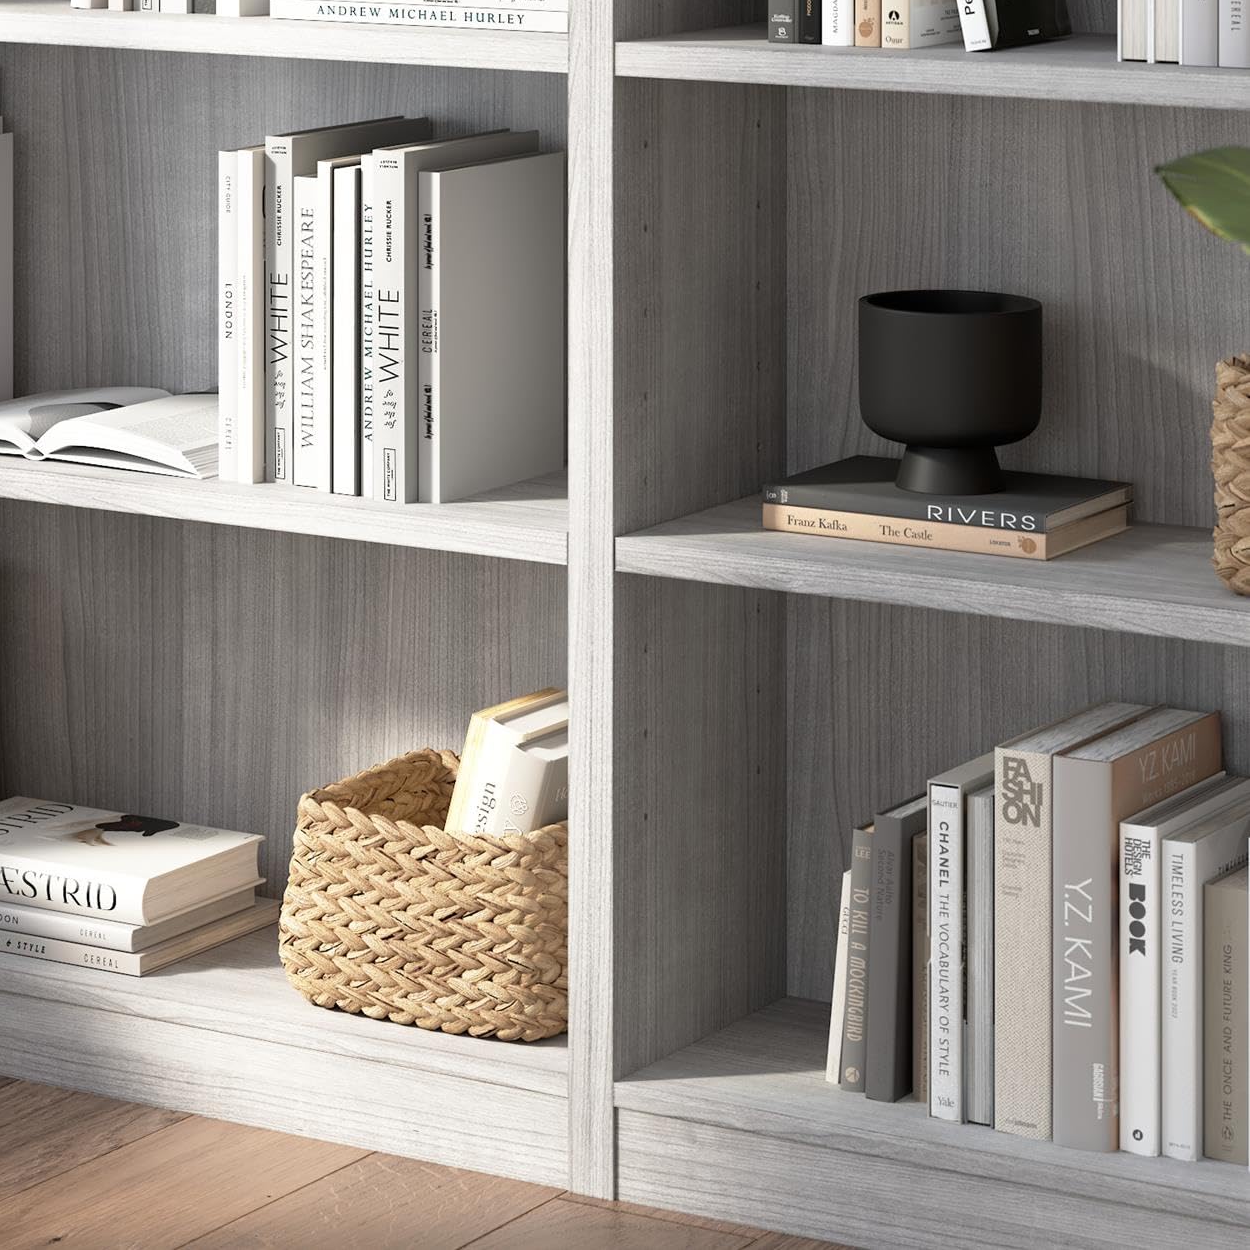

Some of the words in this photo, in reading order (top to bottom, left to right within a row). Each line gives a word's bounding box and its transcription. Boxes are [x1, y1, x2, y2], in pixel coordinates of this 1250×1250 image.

[316, 5, 382, 18] ANDREW
[388, 7, 457, 22] MICHAEL
[464, 11, 526, 25] HURLEY
[364, 203, 374, 272] HURLEY
[301, 207, 314, 350] SHAKESPEARE
[225, 282, 233, 339] LONDON
[270, 272, 288, 364] WHITE
[364, 280, 373, 358] MICHAEL
[378, 289, 399, 383] WHITE
[301, 356, 314, 448] WILLIAM
[364, 367, 374, 442] ANDREW
[786, 514, 816, 528] Franz
[818, 517, 848, 532] Kafka
[879, 524, 901, 538] The
[903, 527, 933, 542] Castle
[927, 503, 1036, 531] RIVERS
[1162, 733, 1197, 770] KAMI
[854, 849, 871, 860] LEE
[939, 821, 950, 888] CHANEL
[1124, 837, 1134, 876] HOTELS
[1132, 839, 1142, 876] DESIGN
[1141, 839, 1151, 860] THE
[853, 887, 870, 904] TO
[1064, 878, 1093, 927] Y.Z.
[1171, 853, 1184, 917] TIMELESS
[841, 906, 849, 935] GUCCI
[851, 909, 868, 935] KILL
[939, 894, 950, 919] THE
[1129, 882, 1146, 957] BOOK
[17, 940, 46, 954] STYLE
[83, 954, 119, 970] CEREAL
[850, 940, 867, 951] A
[1171, 920, 1184, 964] LIVING
[1223, 944, 1233, 975] KING
[938, 923, 950, 1014] VOCABULARY
[1064, 936, 1093, 1028] KAMI
[846, 956, 866, 1042] MOCKINGBIRD
[1223, 978, 1233, 1023] FUTURE
[938, 1015, 950, 1034] OF
[1223, 1026, 1233, 1054] AND
[938, 1038, 950, 1077] STYLE
[1223, 1058, 1233, 1094] ONCE
[937, 1095, 955, 1108] Yale
[1222, 1101, 1233, 1122] THE
